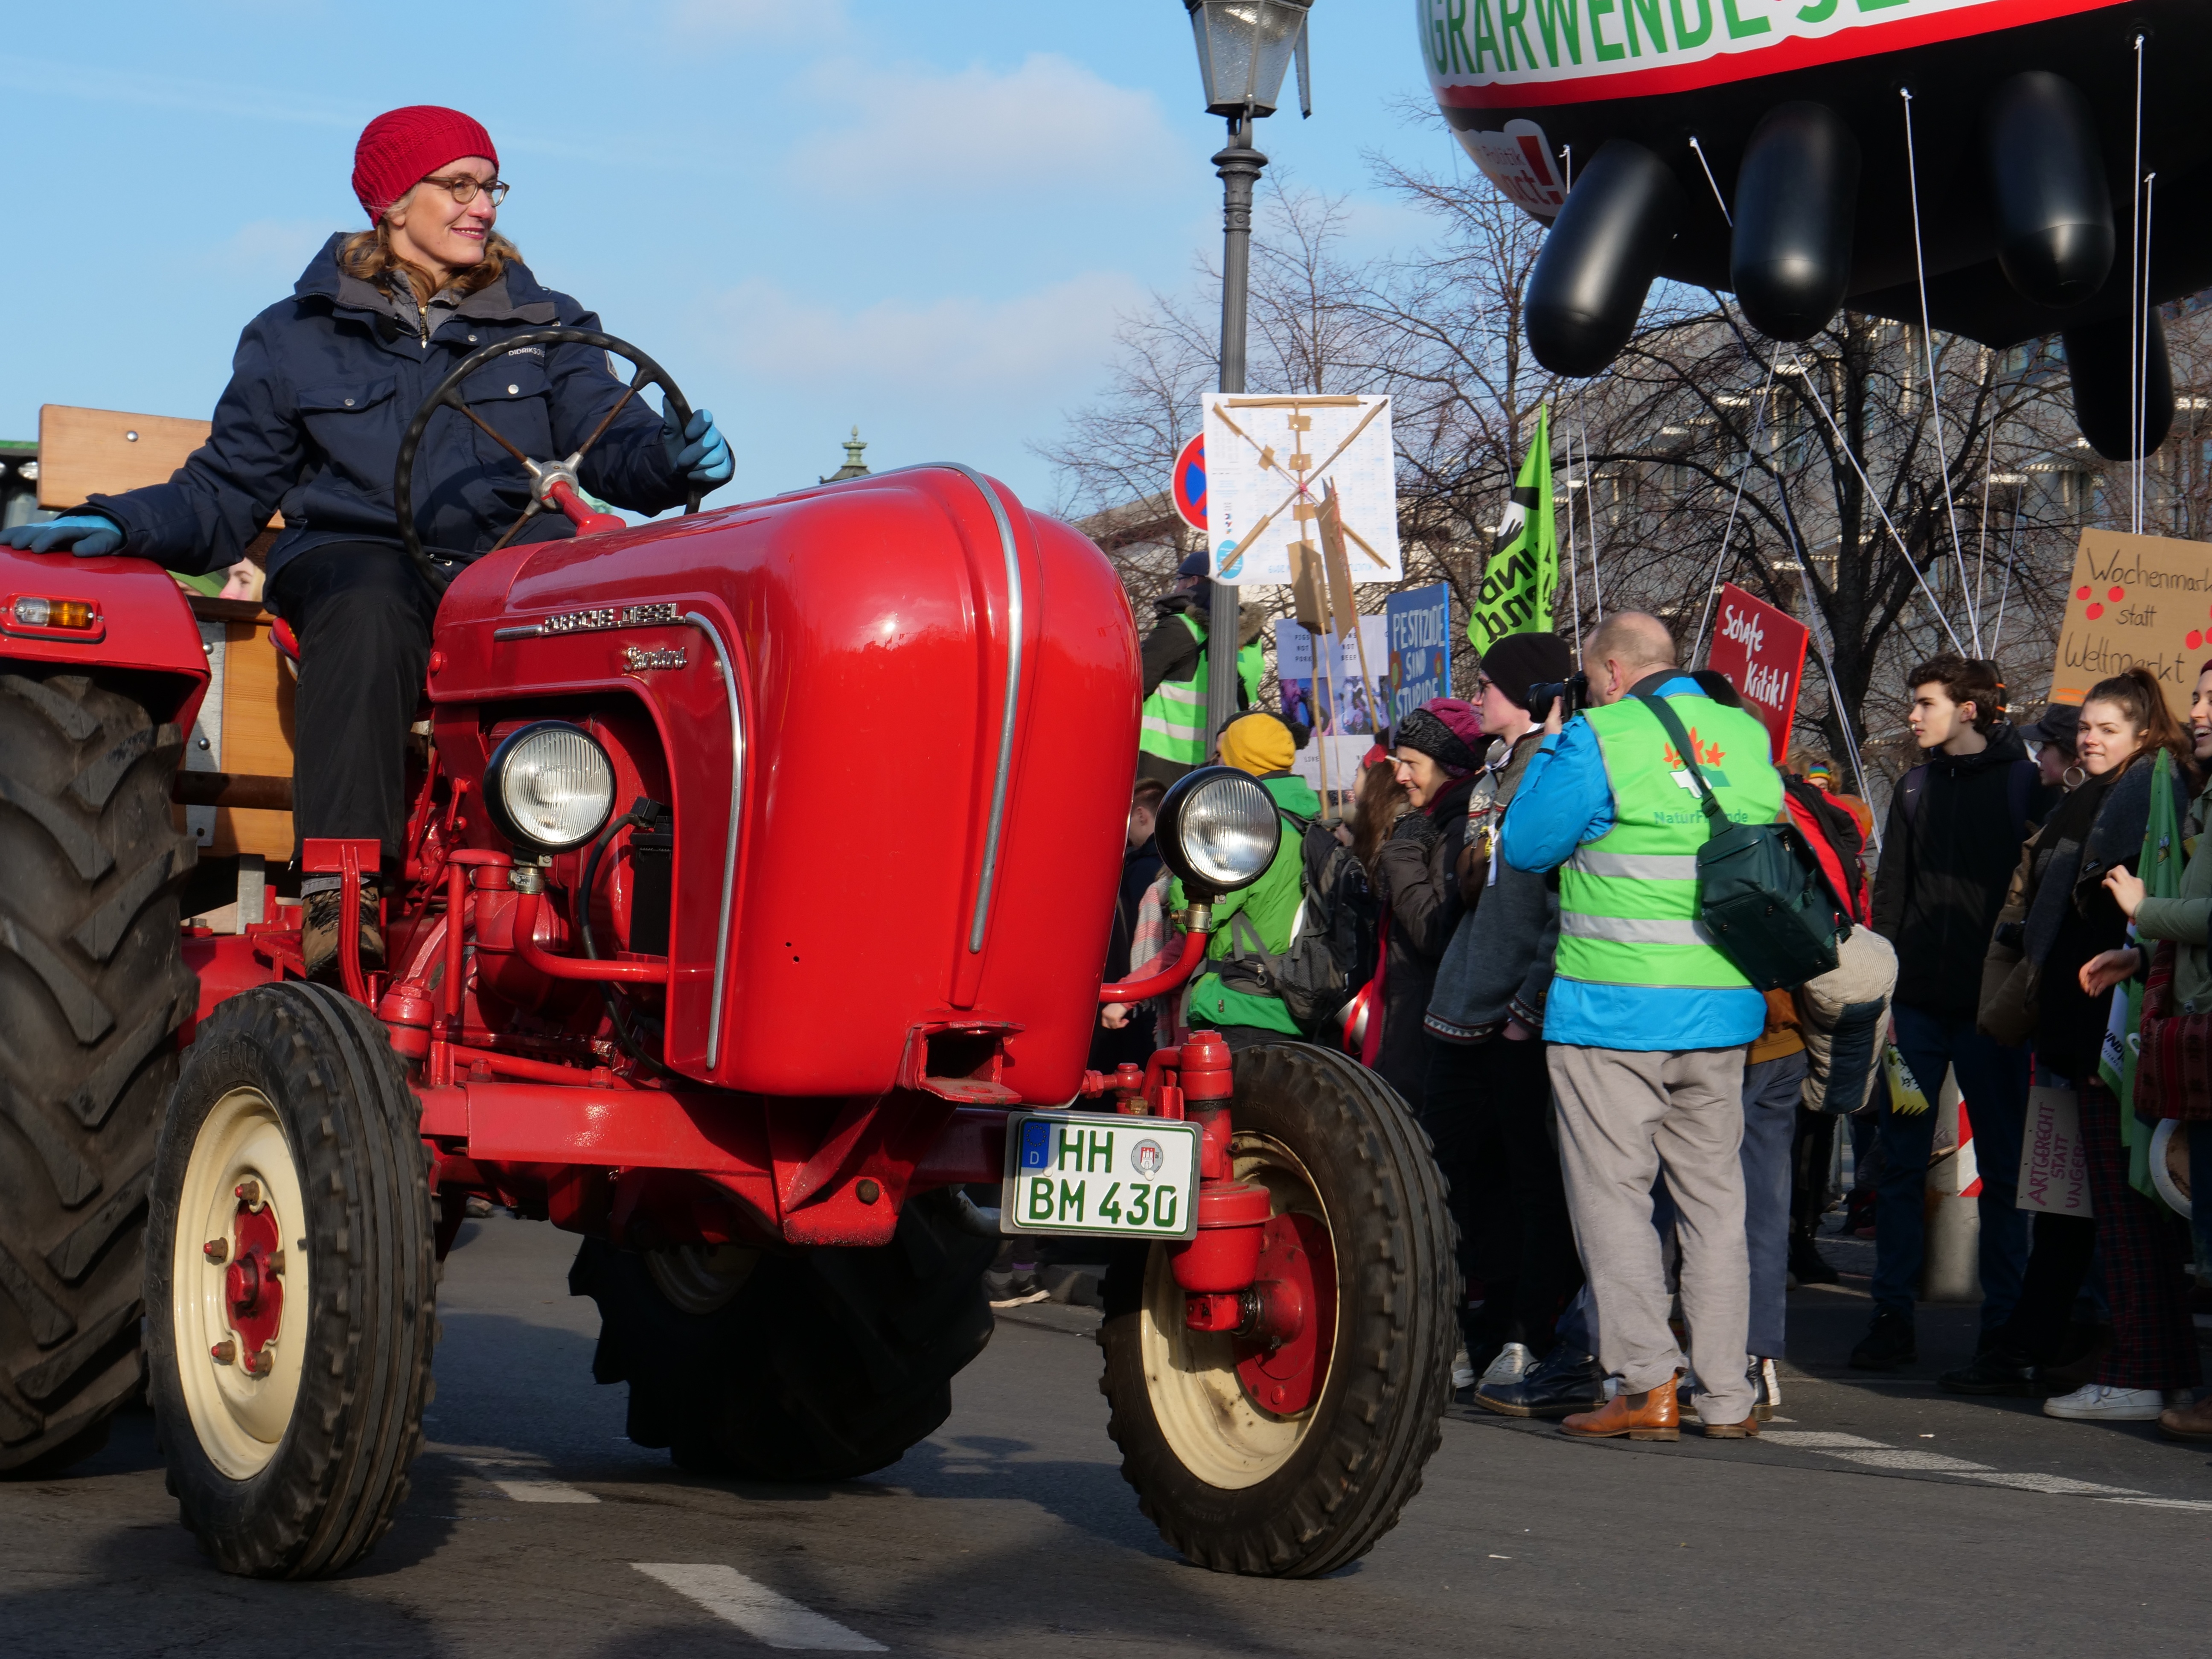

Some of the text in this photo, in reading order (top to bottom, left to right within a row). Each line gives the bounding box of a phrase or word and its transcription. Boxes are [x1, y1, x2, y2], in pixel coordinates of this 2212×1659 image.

[2087, 547, 2212, 592] Wochenmark
[1393, 602, 1446, 652] PESTIZIDE
[1722, 604, 1760, 662] Schafe
[2116, 603, 2157, 628] statt
[1406, 648, 1426, 681] SIND
[2064, 632, 2185, 683] Weltmarkt
[1743, 660, 1786, 711] Kritik!
[1653, 809, 1748, 825] NaturFnde
[1030, 1151, 1039, 1165] D
[1058, 1129, 1114, 1173] HH
[2027, 1101, 2055, 1207] ARTGERECHT
[2050, 1133, 2069, 1180] STATT
[1029, 1177, 1177, 1227] BM 430
